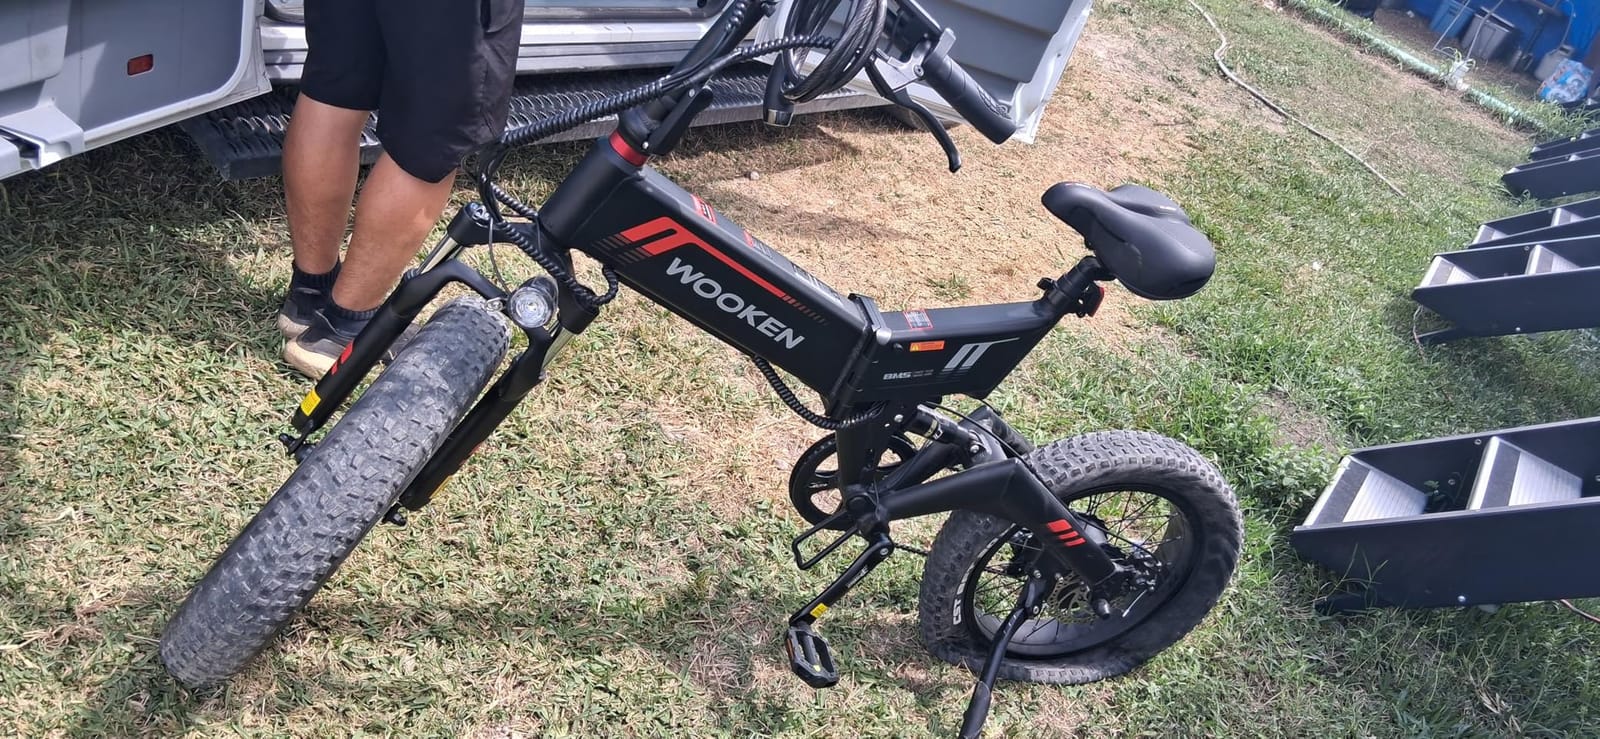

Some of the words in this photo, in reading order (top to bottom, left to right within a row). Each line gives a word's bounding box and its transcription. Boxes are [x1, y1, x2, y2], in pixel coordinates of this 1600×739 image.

[666, 257, 805, 349] WOOKEN
[883, 371, 912, 380] BMS
[953, 598, 962, 625] CST
